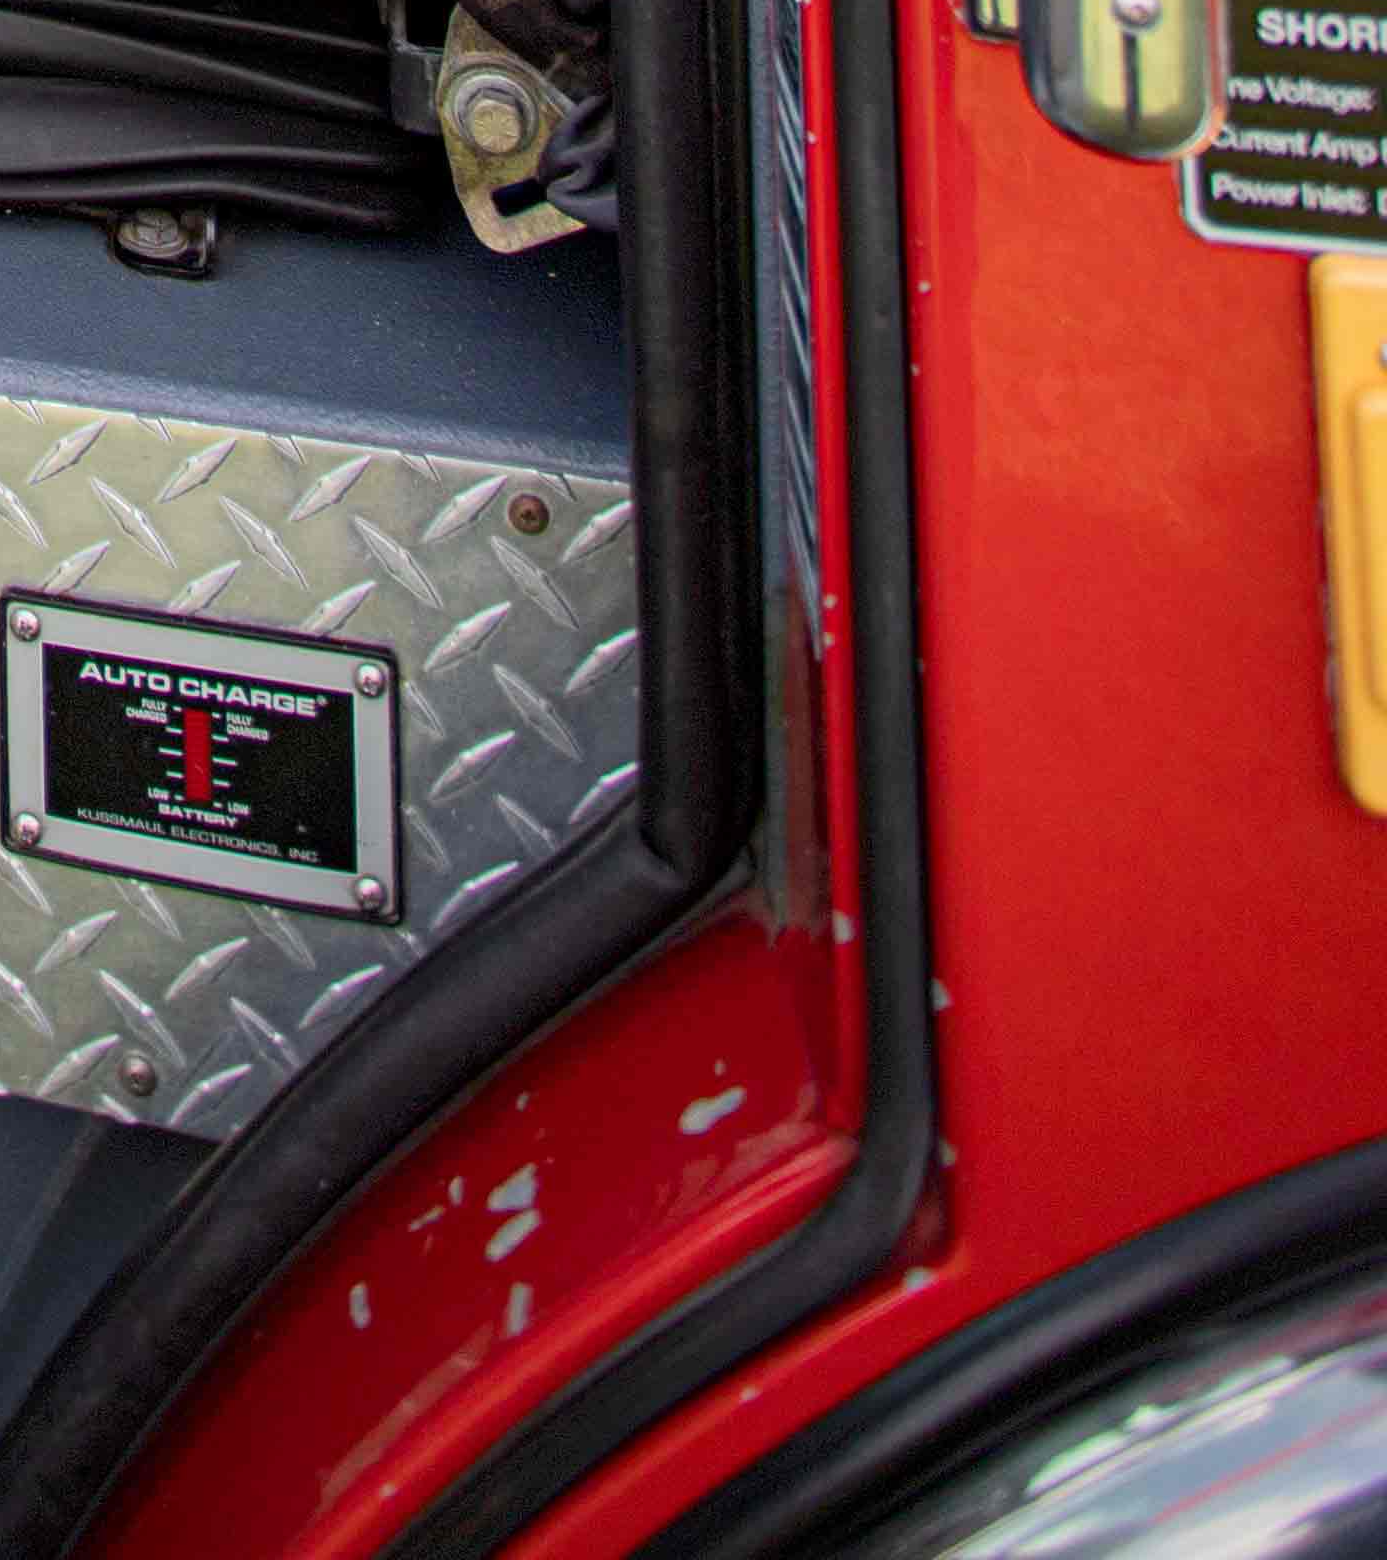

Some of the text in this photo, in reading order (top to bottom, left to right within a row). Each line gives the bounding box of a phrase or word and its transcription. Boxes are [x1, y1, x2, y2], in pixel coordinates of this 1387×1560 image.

[1257, 7, 1387, 53] SHOR
[1312, 131, 1379, 169] Amp
[1209, 172, 1300, 208] Power
[79, 661, 172, 692] AUTO
[126, 706, 168, 724] CHARGED
[141, 698, 168, 711] FULLY
[147, 787, 170, 801] LOW
[77, 807, 166, 836] KUSSMAUL
[158, 803, 238, 828] BATTERY
[227, 802, 250, 815] LOW
